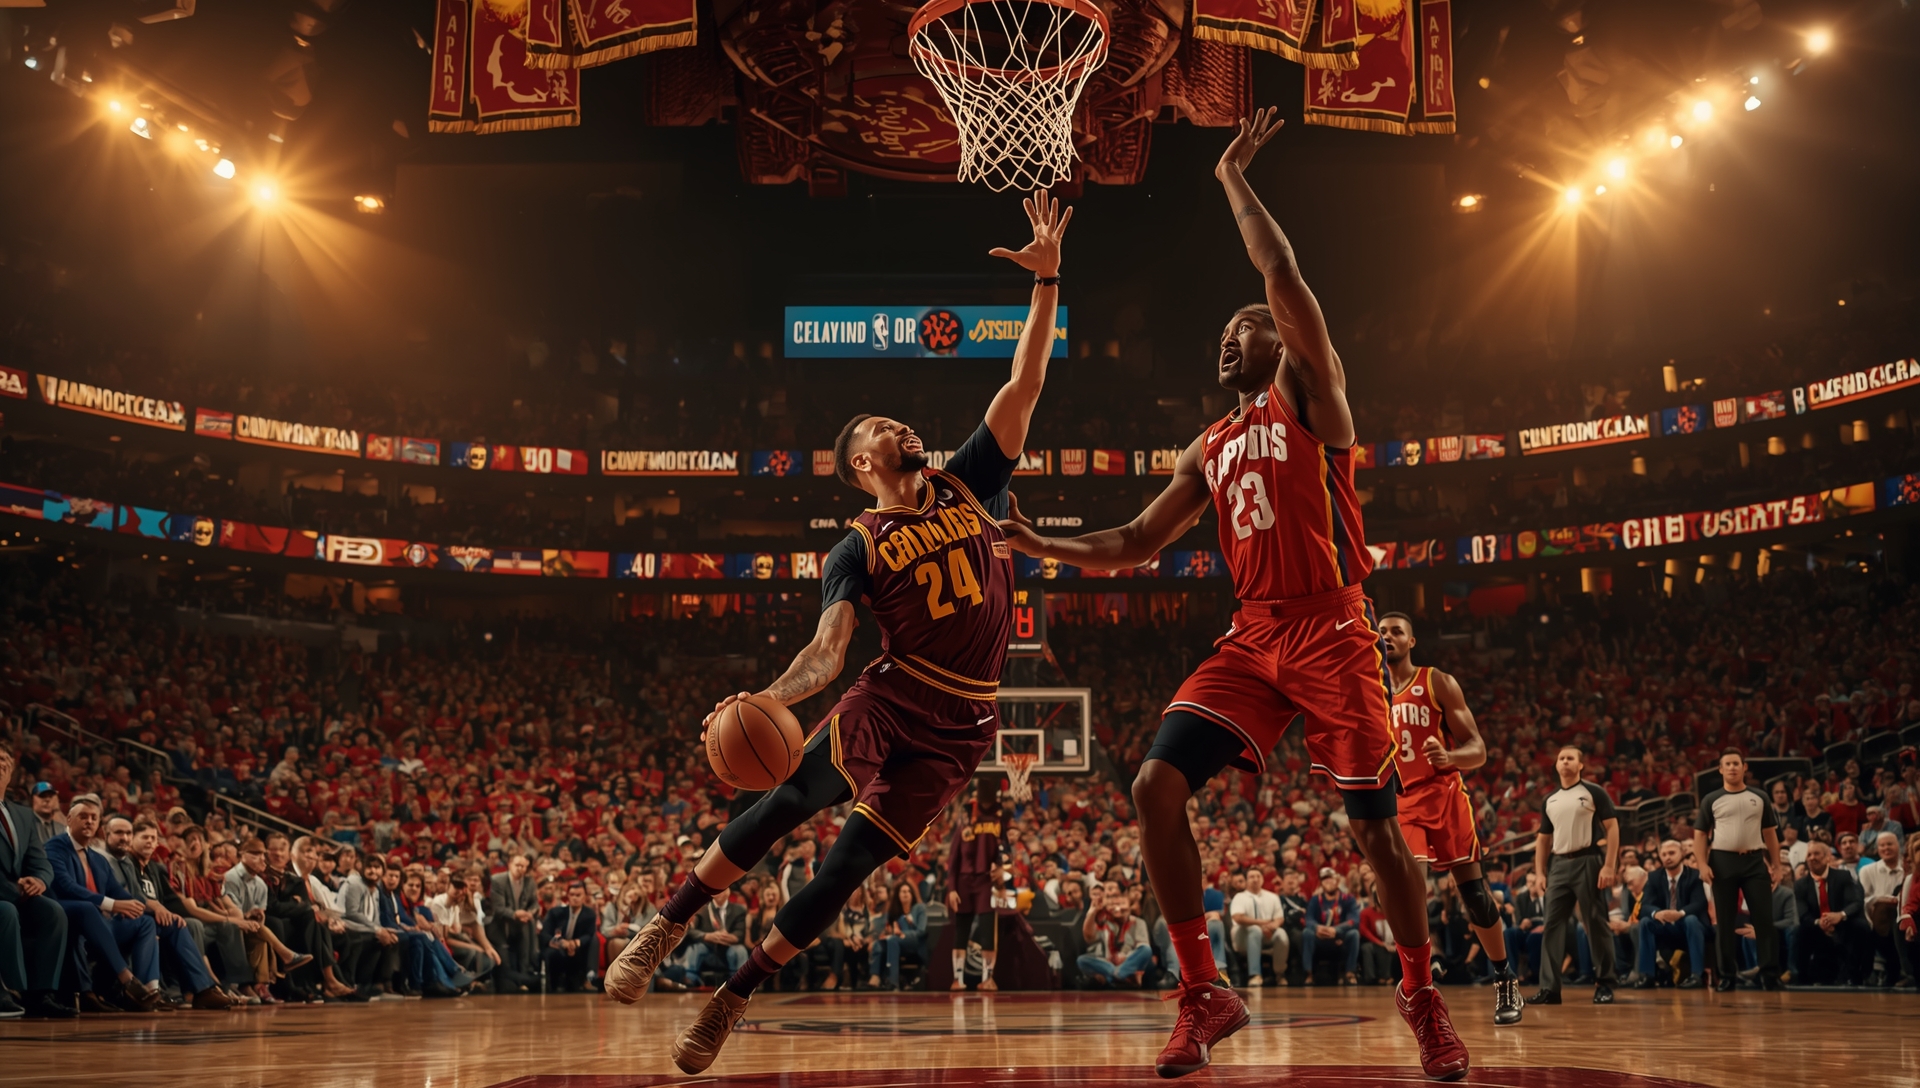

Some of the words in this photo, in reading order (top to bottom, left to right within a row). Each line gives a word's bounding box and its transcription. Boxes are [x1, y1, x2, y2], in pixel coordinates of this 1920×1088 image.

[894, 317, 917, 344] OR
[1226, 471, 1276, 541] 23
[631, 552, 656, 579] 40
[914, 547, 984, 621] 24
[1399, 729, 1416, 763] 3
